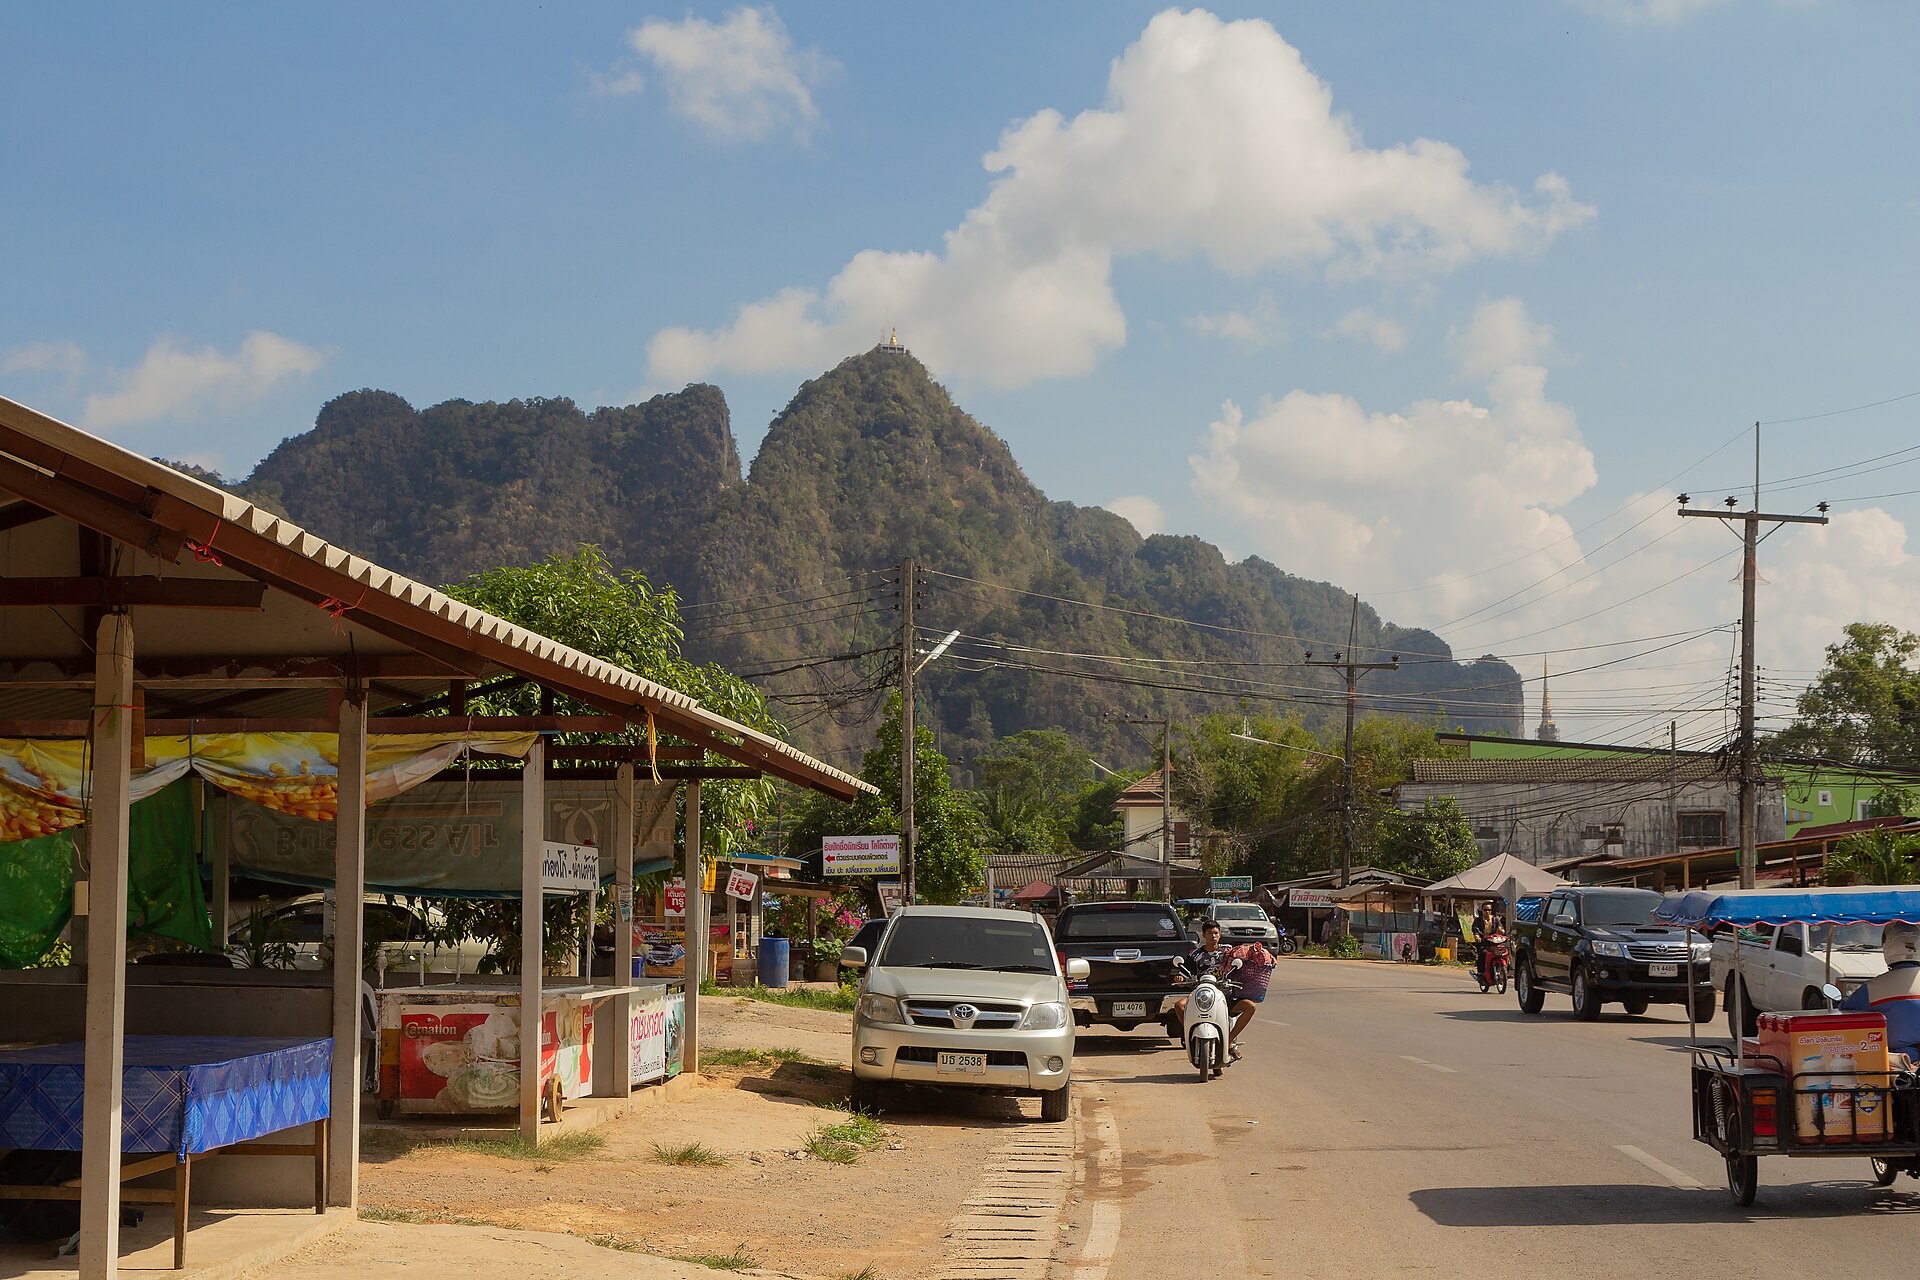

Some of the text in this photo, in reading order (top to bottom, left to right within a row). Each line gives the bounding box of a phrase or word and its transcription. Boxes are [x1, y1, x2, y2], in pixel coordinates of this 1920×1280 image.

[1126, 1003, 1143, 1011] 4076
[404, 1021, 457, 1039] Carnation
[1860, 1041, 1868, 1052] 2
[958, 1056, 982, 1066] 2538
